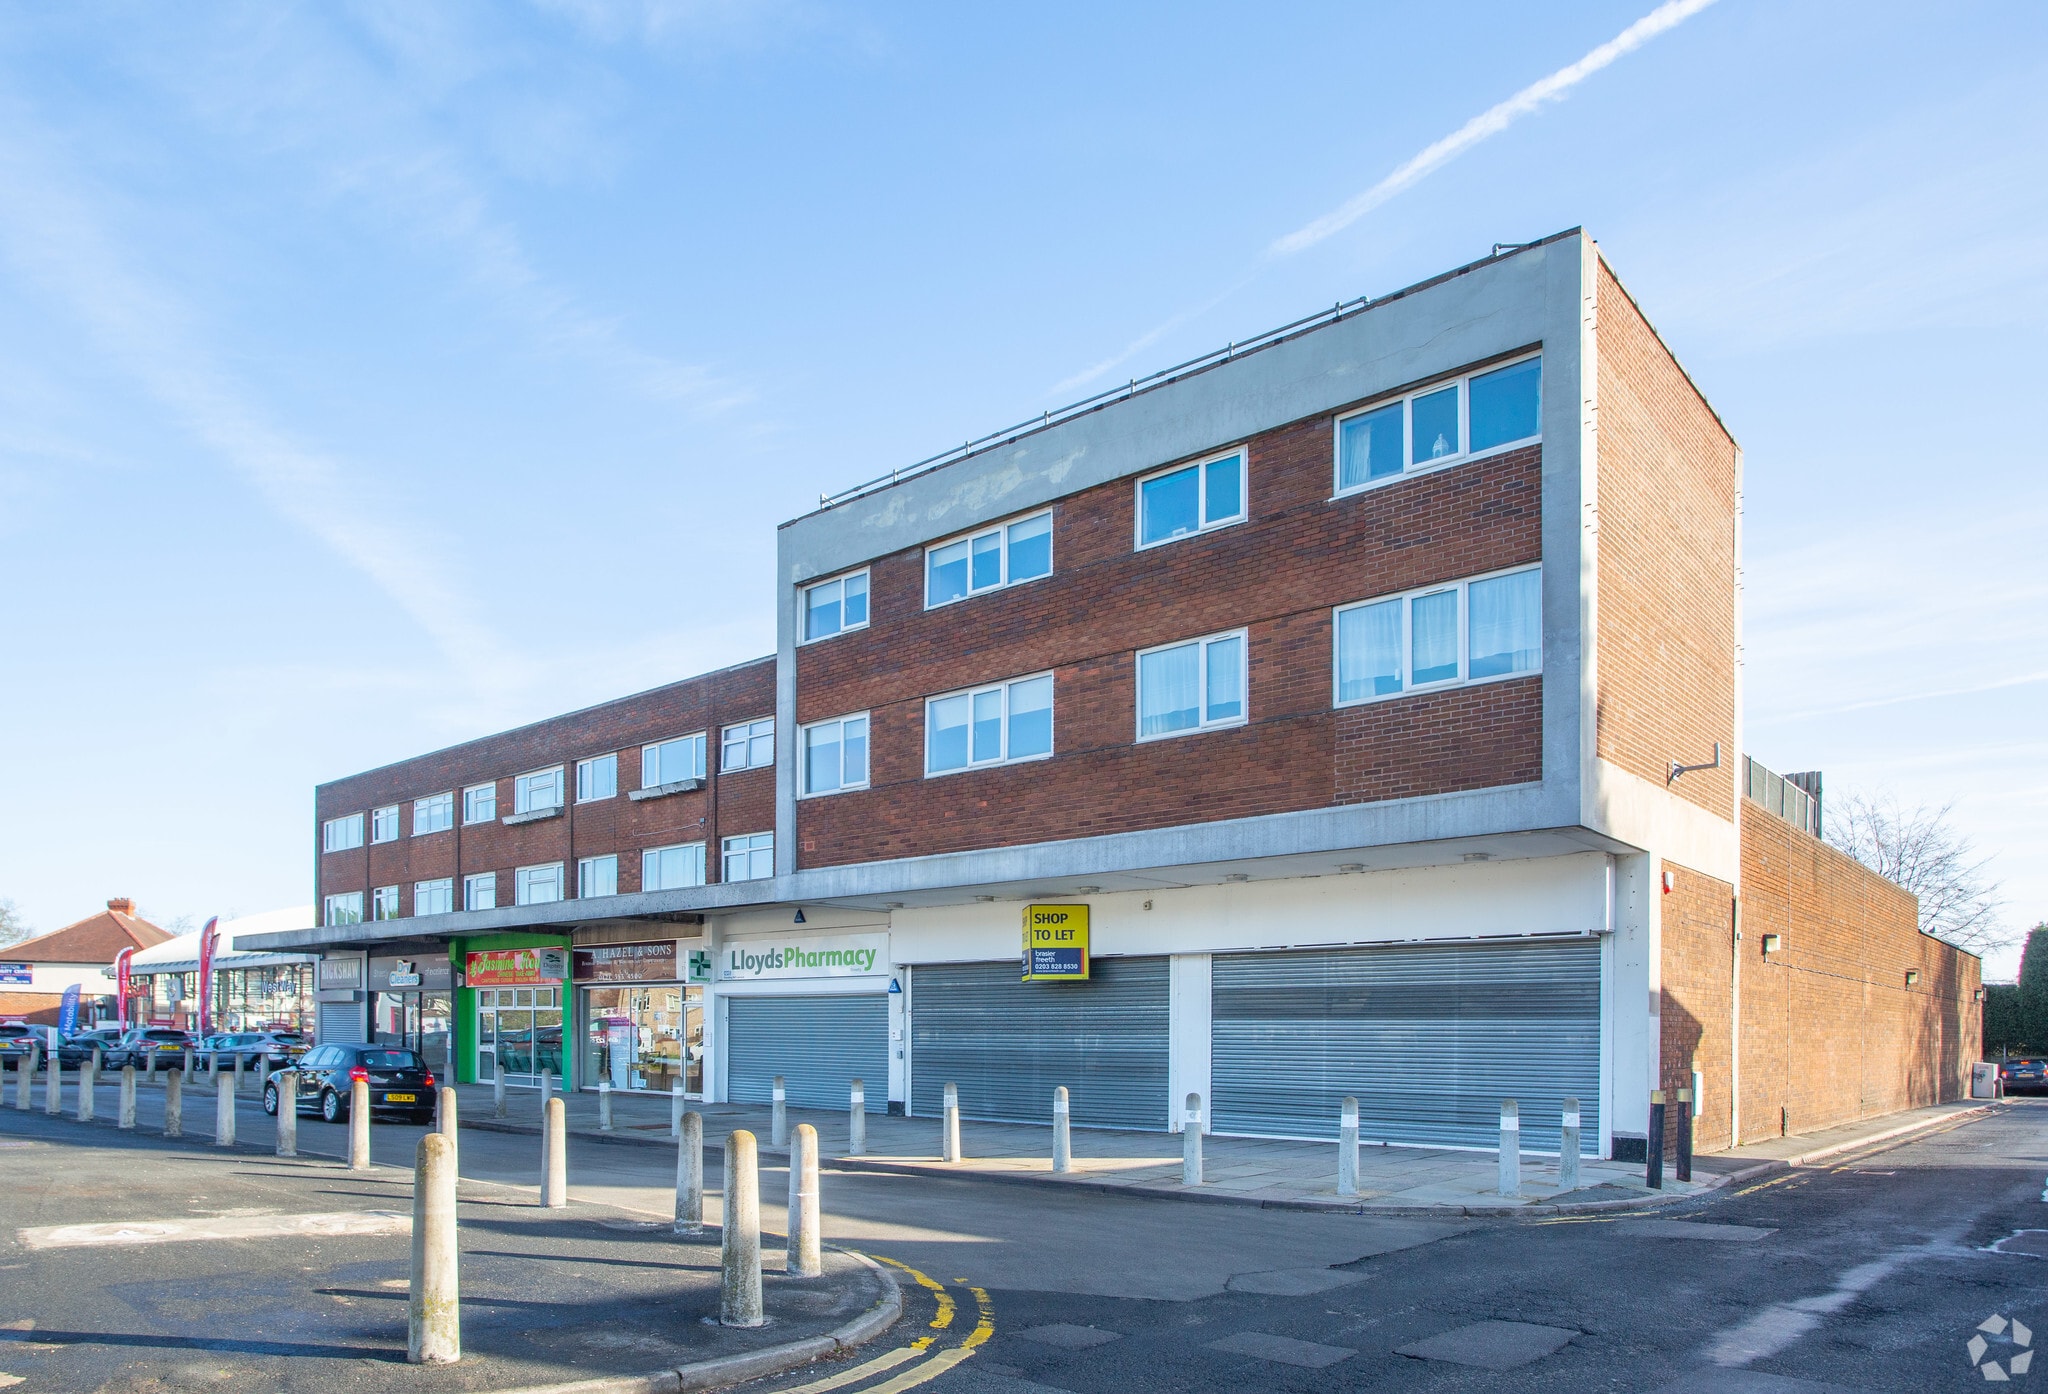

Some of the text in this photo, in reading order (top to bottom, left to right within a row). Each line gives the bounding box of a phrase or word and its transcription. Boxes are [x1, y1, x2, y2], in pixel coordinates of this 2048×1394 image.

[1034, 913, 1068, 924] SHOP
[1034, 929, 1075, 940] TO LET
[602, 946, 634, 959] HAZEL
[637, 946, 644, 956] &
[647, 944, 672, 956] SONS
[477, 953, 515, 974] Jasmine
[519, 951, 541, 971] Hou
[731, 946, 877, 975] LloydsPharmacy
[321, 961, 359, 980] RICKSHAW
[397, 961, 411, 975] Dry
[390, 973, 419, 985] Cleaners
[690, 975, 711, 983] Pharmacy
